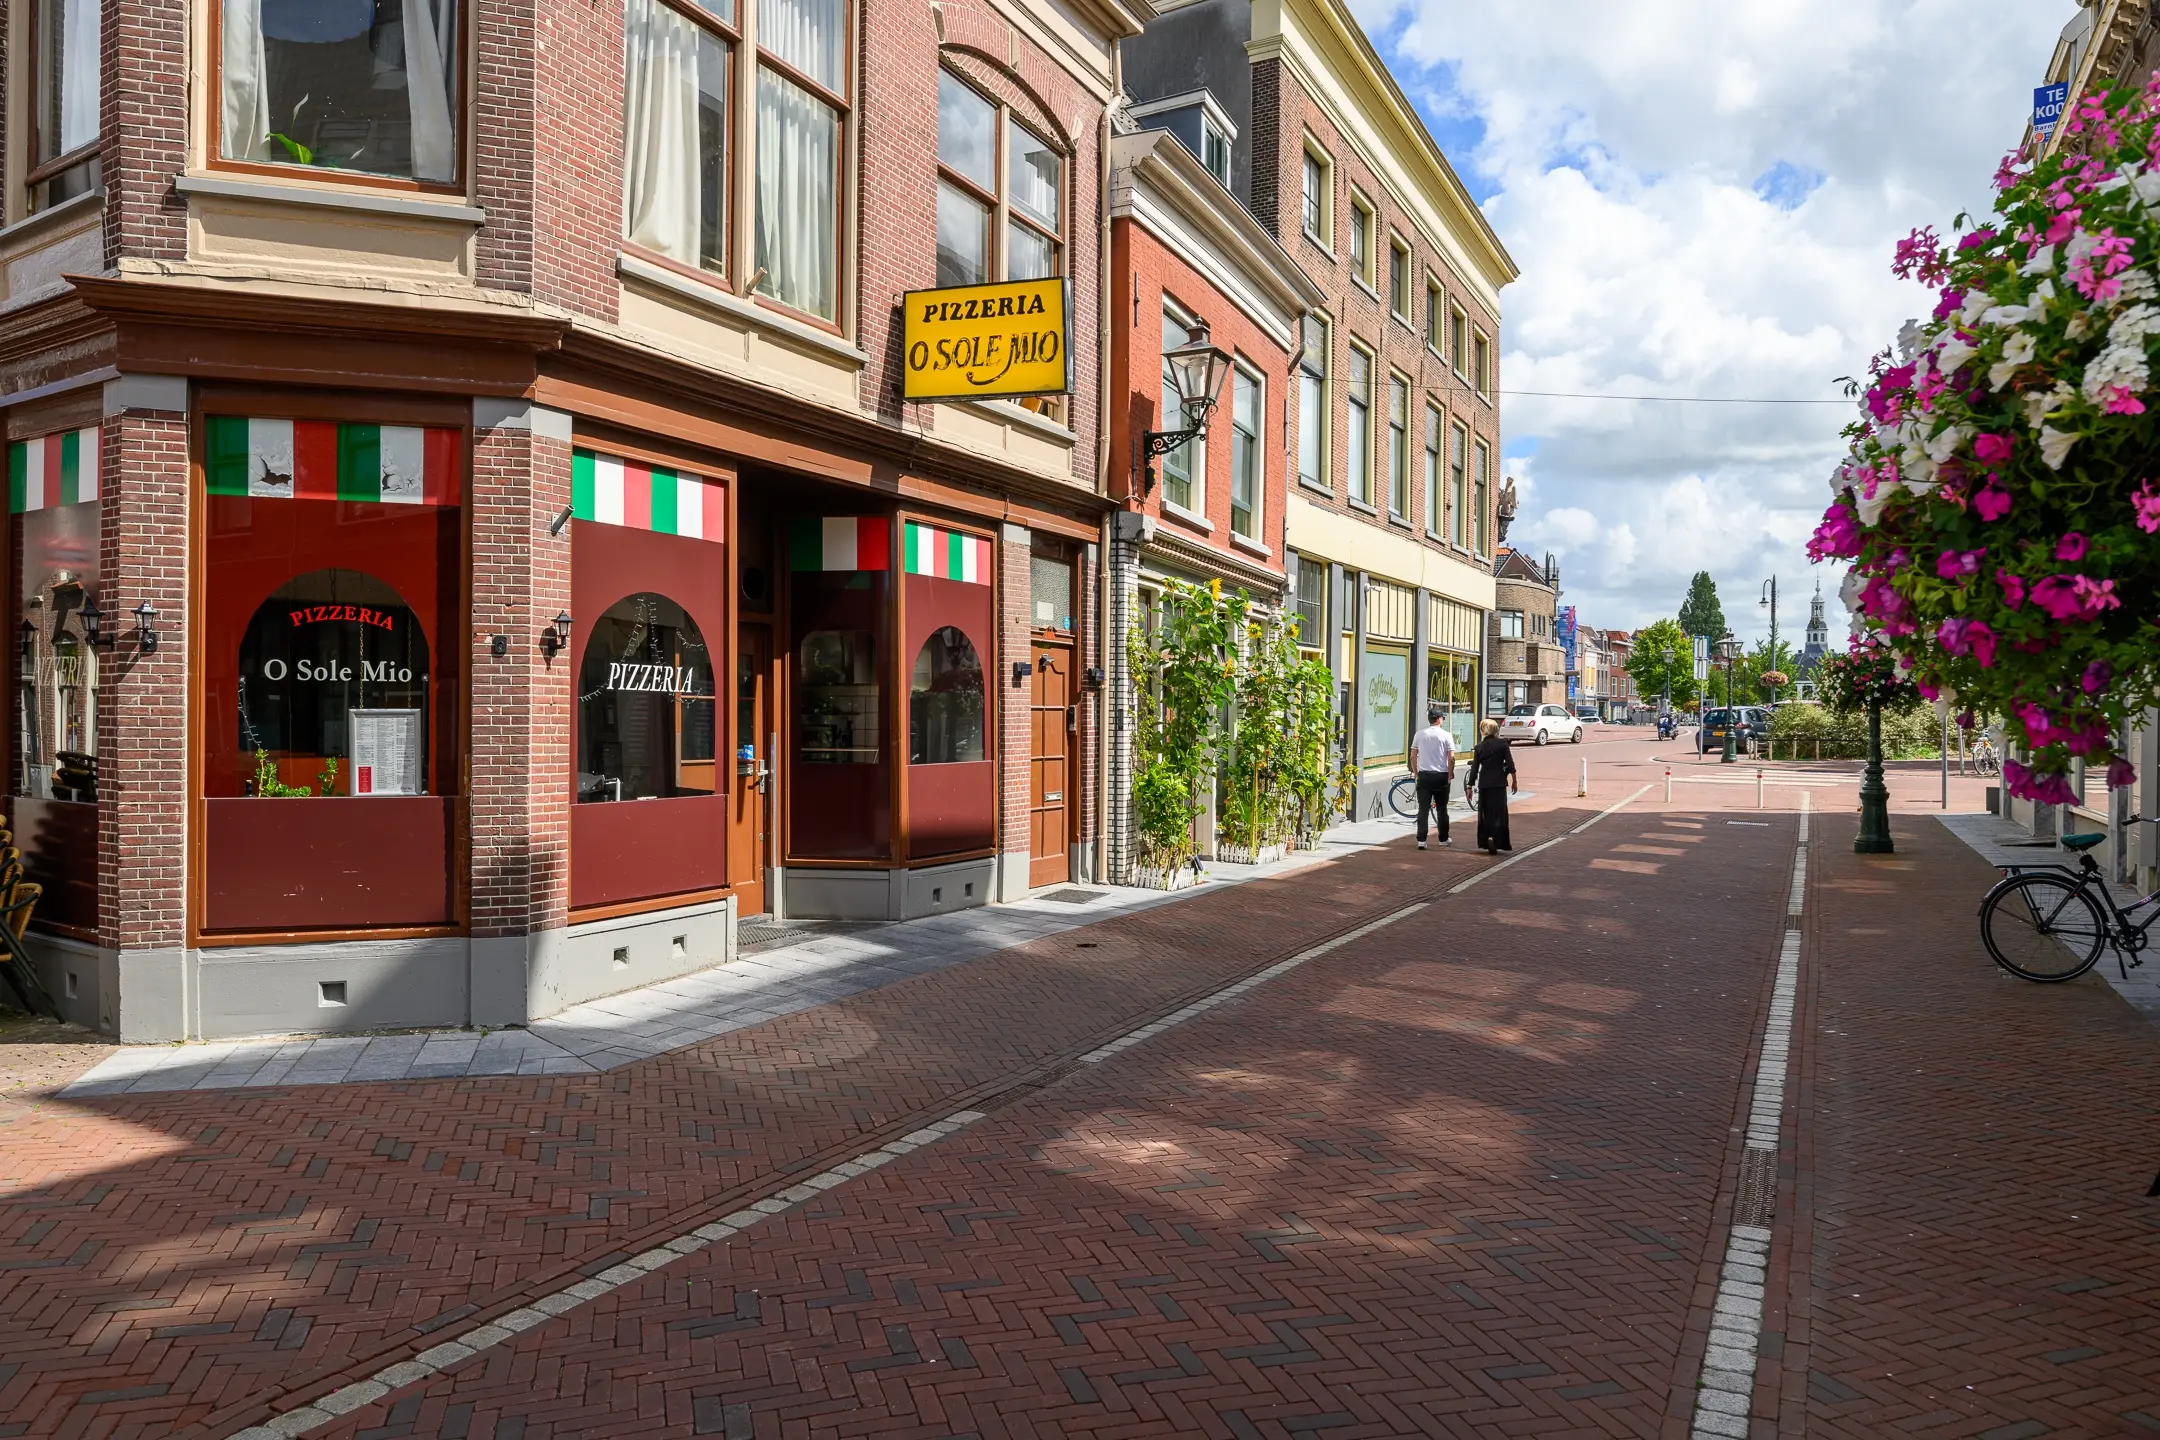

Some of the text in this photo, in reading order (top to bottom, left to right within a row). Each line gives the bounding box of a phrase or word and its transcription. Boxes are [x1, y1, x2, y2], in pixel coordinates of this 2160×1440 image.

[2046, 88, 2064, 102] TE
[2036, 102, 2065, 119] KOO
[922, 294, 1045, 323] PIZZERIA
[909, 340, 929, 371] O
[933, 335, 1002, 372] SOLE
[289, 605, 393, 631] PIZZERIA
[264, 659, 413, 683] O Sole Mio
[606, 662, 694, 693] PIZZERIA
